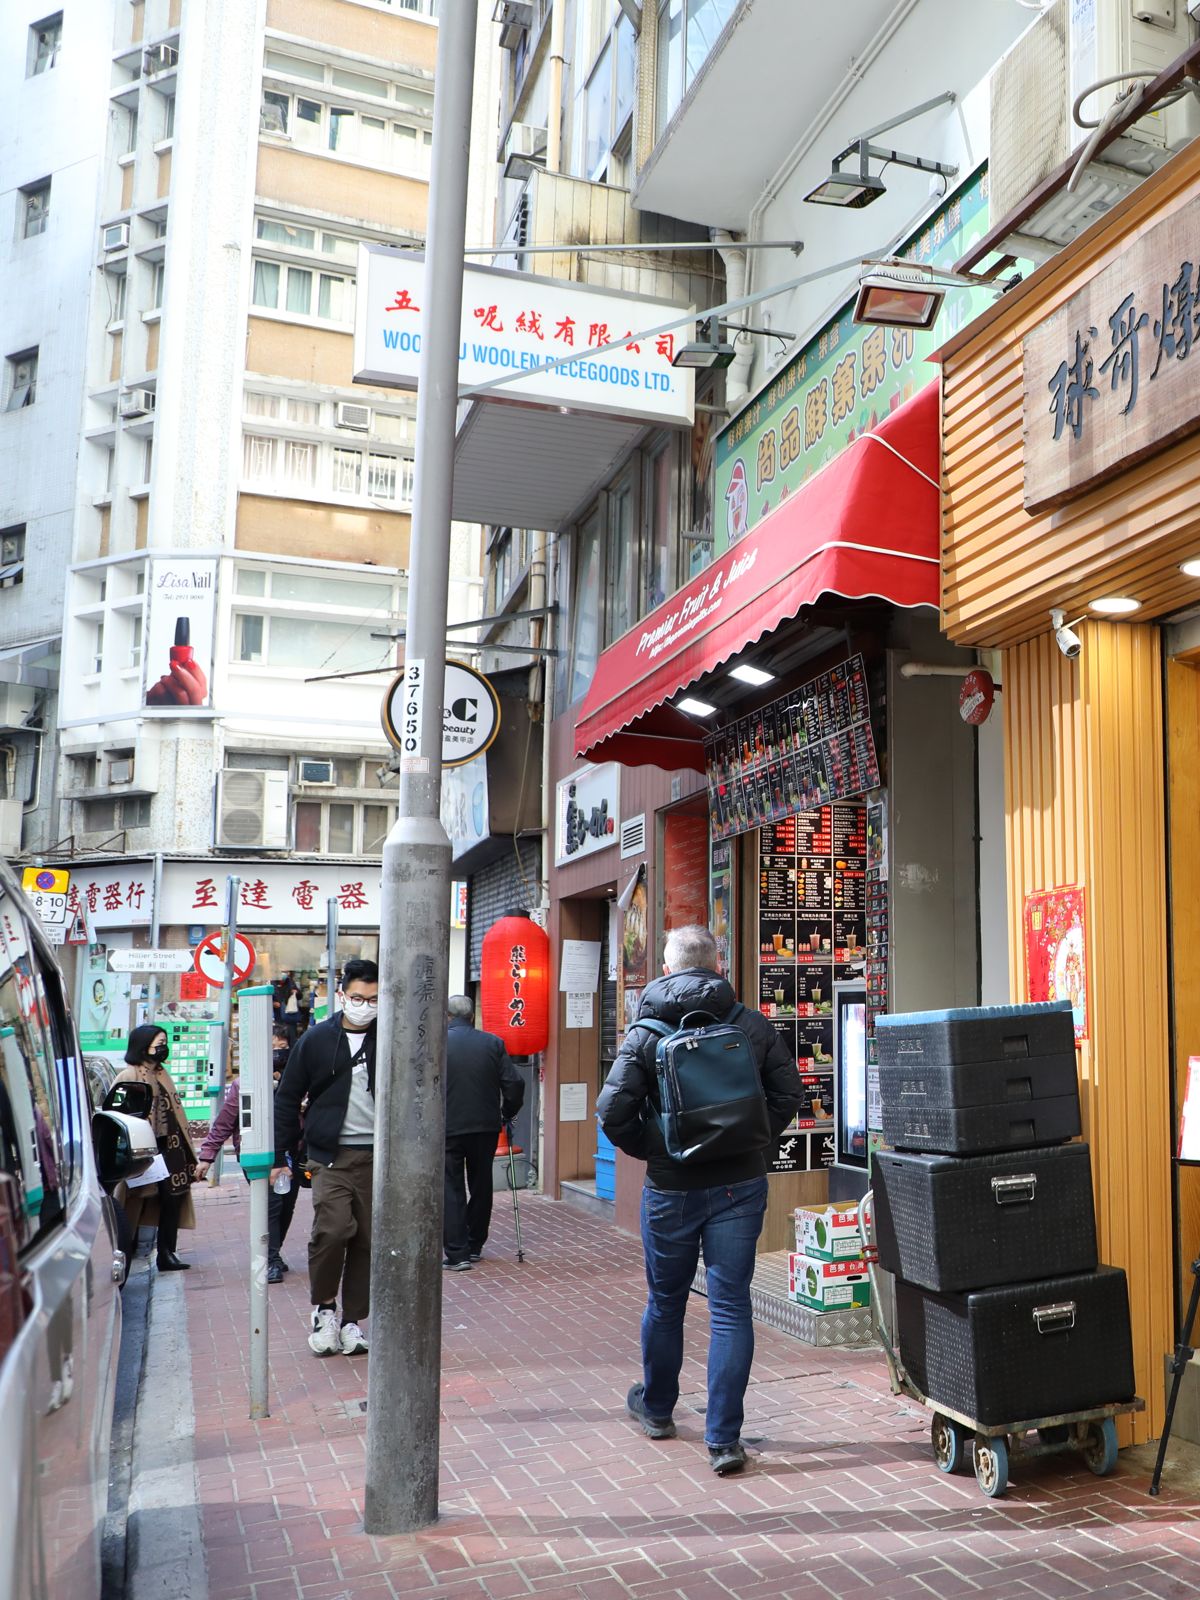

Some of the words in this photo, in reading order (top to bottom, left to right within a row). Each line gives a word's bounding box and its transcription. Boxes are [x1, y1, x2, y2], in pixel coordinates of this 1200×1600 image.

[473, 344, 541, 371] WOOLEN
[645, 371, 676, 393] LTD.
[678, 583, 710, 624] Fruit
[722, 547, 758, 589] Juice
[404, 666, 420, 752] 37650
[192, 878, 367, 911] 至達電器
[153, 952, 176, 960] Street
[509, 944, 526, 1027] 熊らーめん
